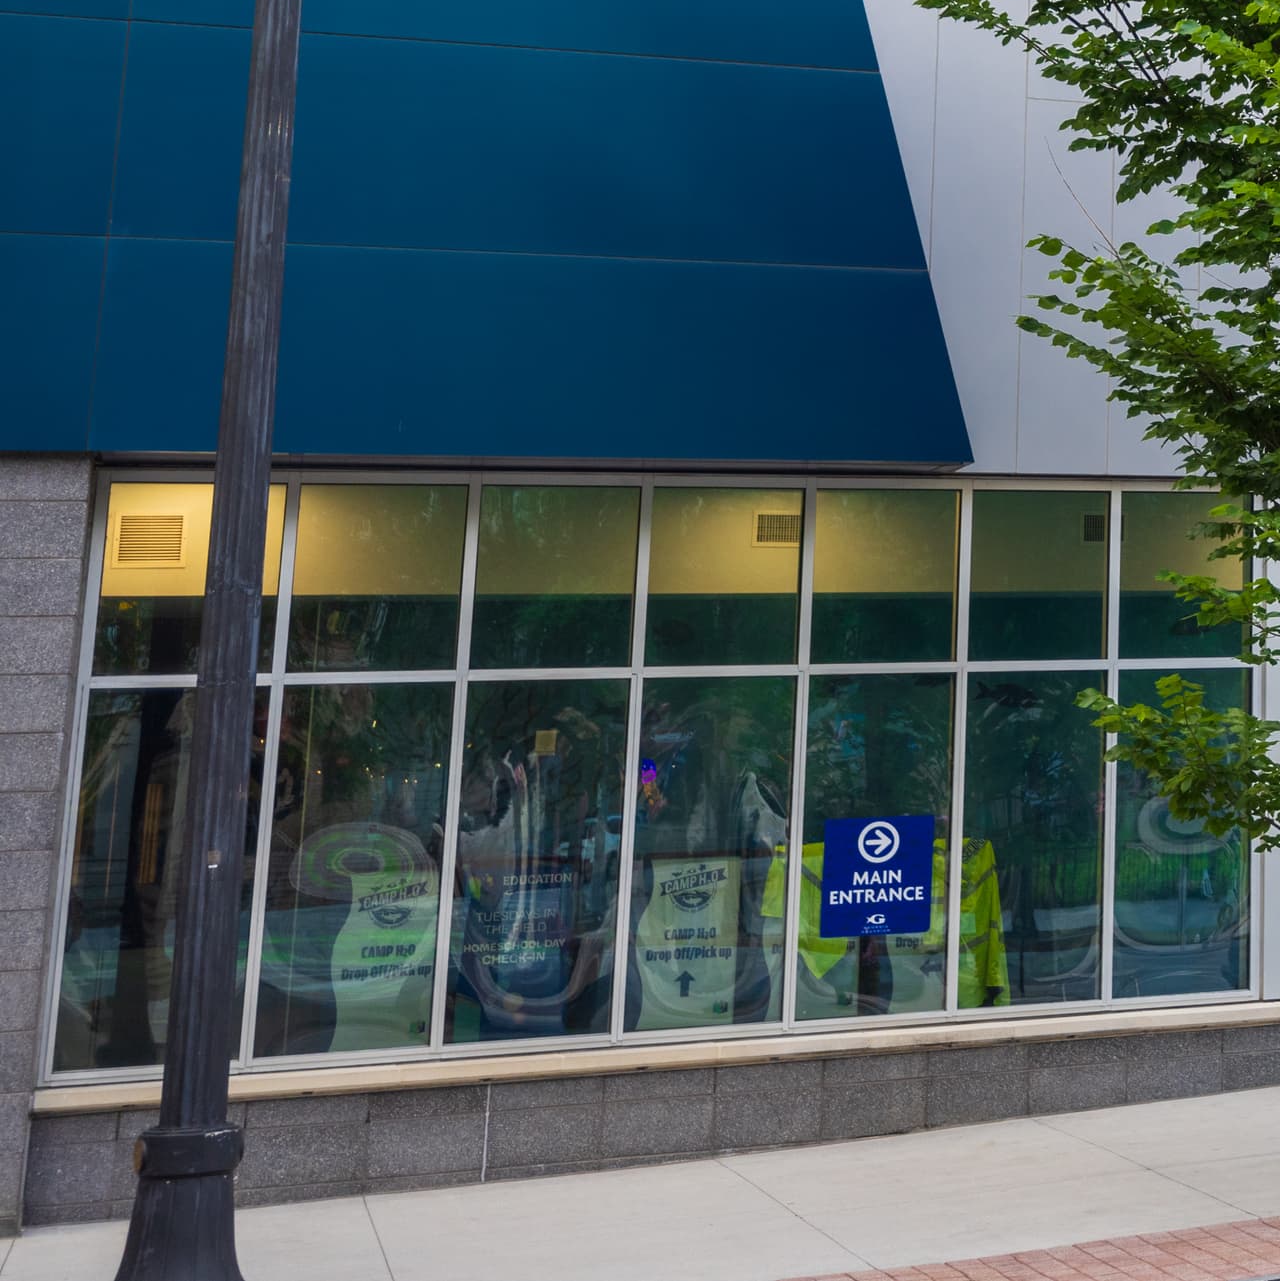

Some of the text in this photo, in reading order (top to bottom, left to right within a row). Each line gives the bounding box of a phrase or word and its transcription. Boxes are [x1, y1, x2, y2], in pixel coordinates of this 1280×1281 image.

[503, 872, 572, 886] EDUCATION
[664, 875, 696, 893] CAMP
[852, 869, 902, 886] MAIN
[829, 886, 924, 905] ENTRANCE
[664, 928, 695, 940] CAMP
[544, 938, 565, 948] DAY
[361, 945, 394, 959] CAMP
[645, 947, 732, 963] Drop Off/Pick up
[341, 967, 369, 981] Drop
[417, 965, 432, 979] up
